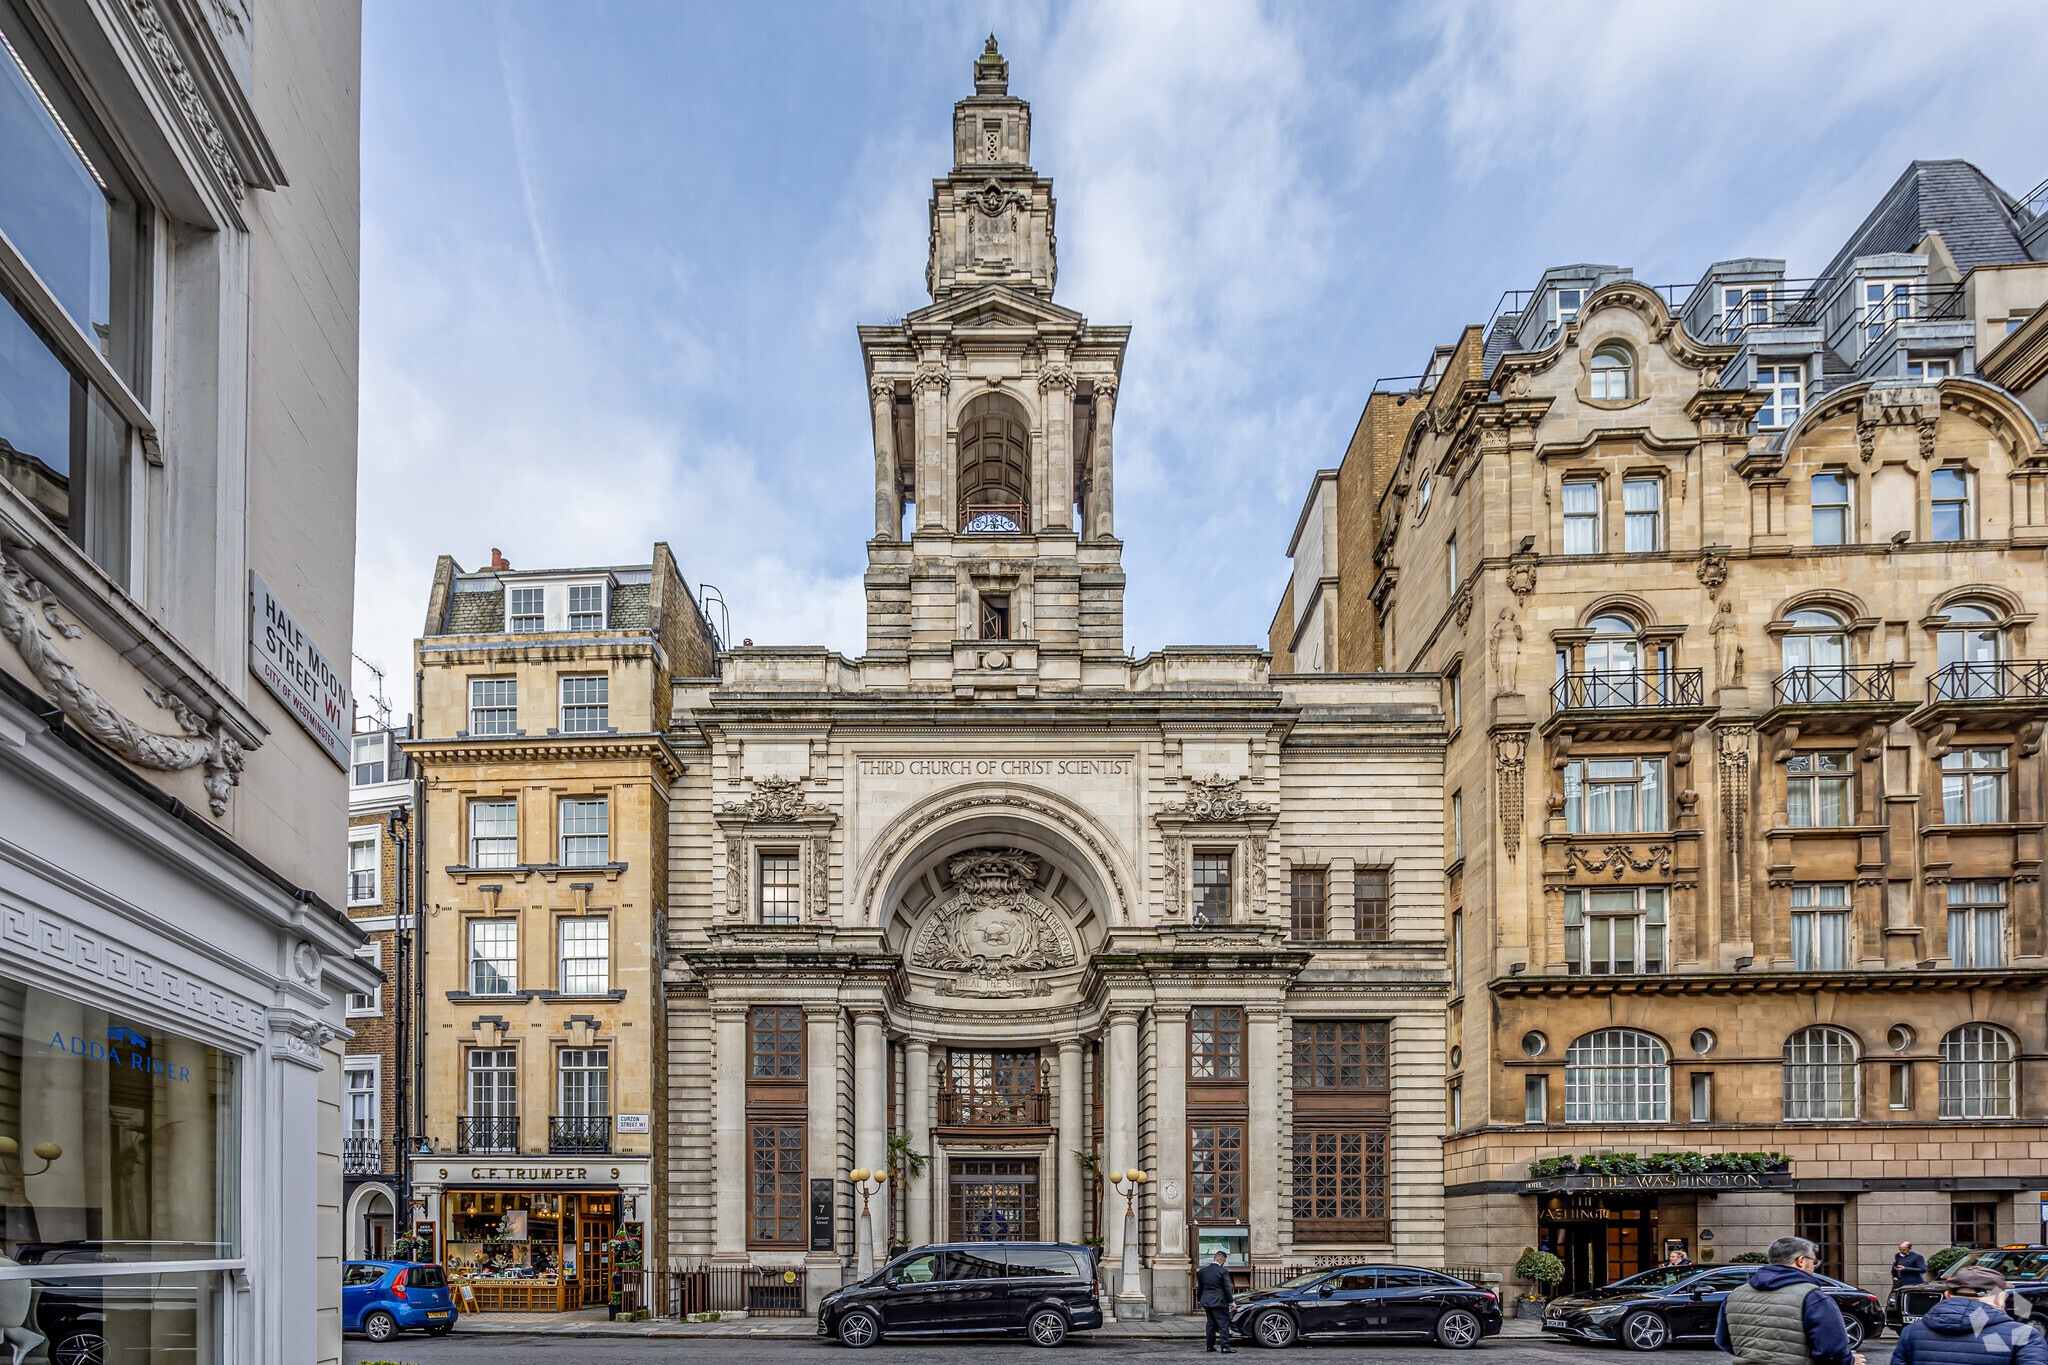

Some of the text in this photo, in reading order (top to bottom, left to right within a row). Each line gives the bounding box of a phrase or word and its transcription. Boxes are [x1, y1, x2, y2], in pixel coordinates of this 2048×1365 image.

[265, 592, 346, 710] HALF MOON
[265, 625, 341, 730] STREET W1
[264, 664, 335, 750] CITY OF WESTMINSTER
[860, 760, 1132, 775] THIRD CHURCH OF CHRIST SCIENTIST
[916, 919, 936, 954] CLEANSE
[942, 894, 970, 914] LEPER
[1019, 893, 1042, 914] RAISE
[1058, 931, 1072, 955] DEAD
[959, 978, 1027, 988] HEAL THE SICK
[49, 1031, 190, 1083] ADDA RIVER
[438, 1168, 449, 1179] 9
[506, 1168, 587, 1180] TRUMPER
[610, 1168, 620, 1179] 9
[1525, 1181, 1544, 1189] HOTEL
[1587, 1174, 1762, 1188] THE WASHINGTON
[819, 1204, 825, 1213] 7
